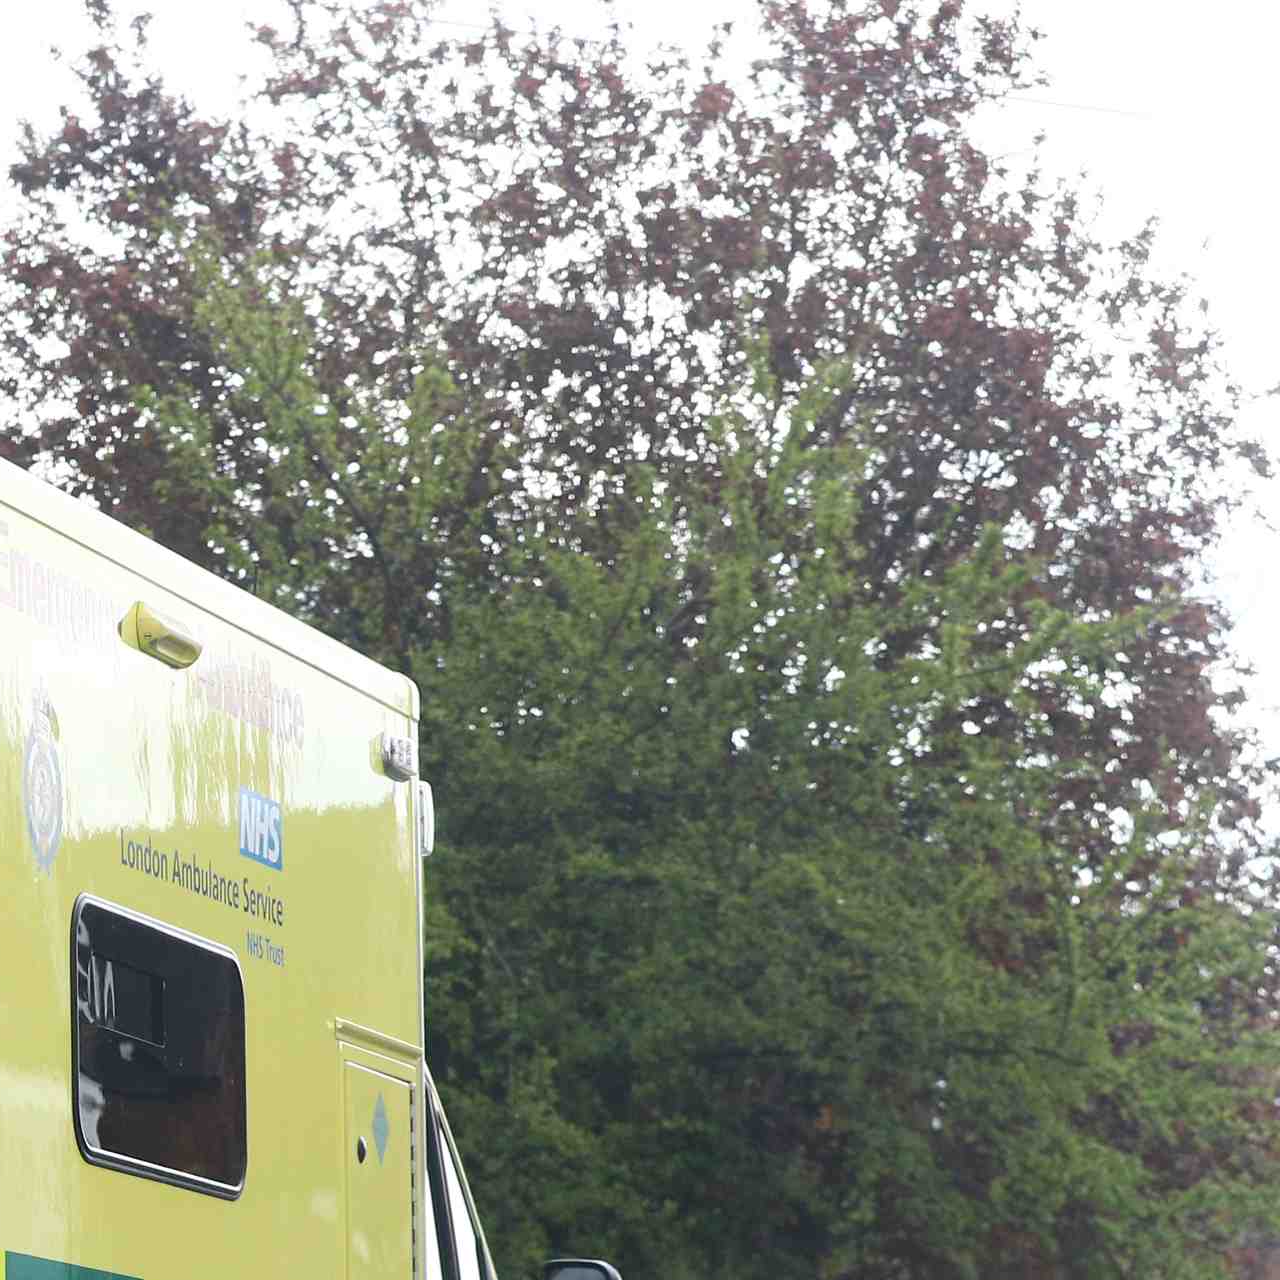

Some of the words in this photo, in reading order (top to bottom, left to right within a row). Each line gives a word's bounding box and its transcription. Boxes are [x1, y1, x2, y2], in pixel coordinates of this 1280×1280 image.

[241, 793, 280, 863] NHS
[120, 828, 168, 880] London
[172, 850, 239, 908] Ambulance
[243, 878, 283, 926] Service
[247, 929, 263, 959] NHS
[265, 938, 285, 966] Trust
